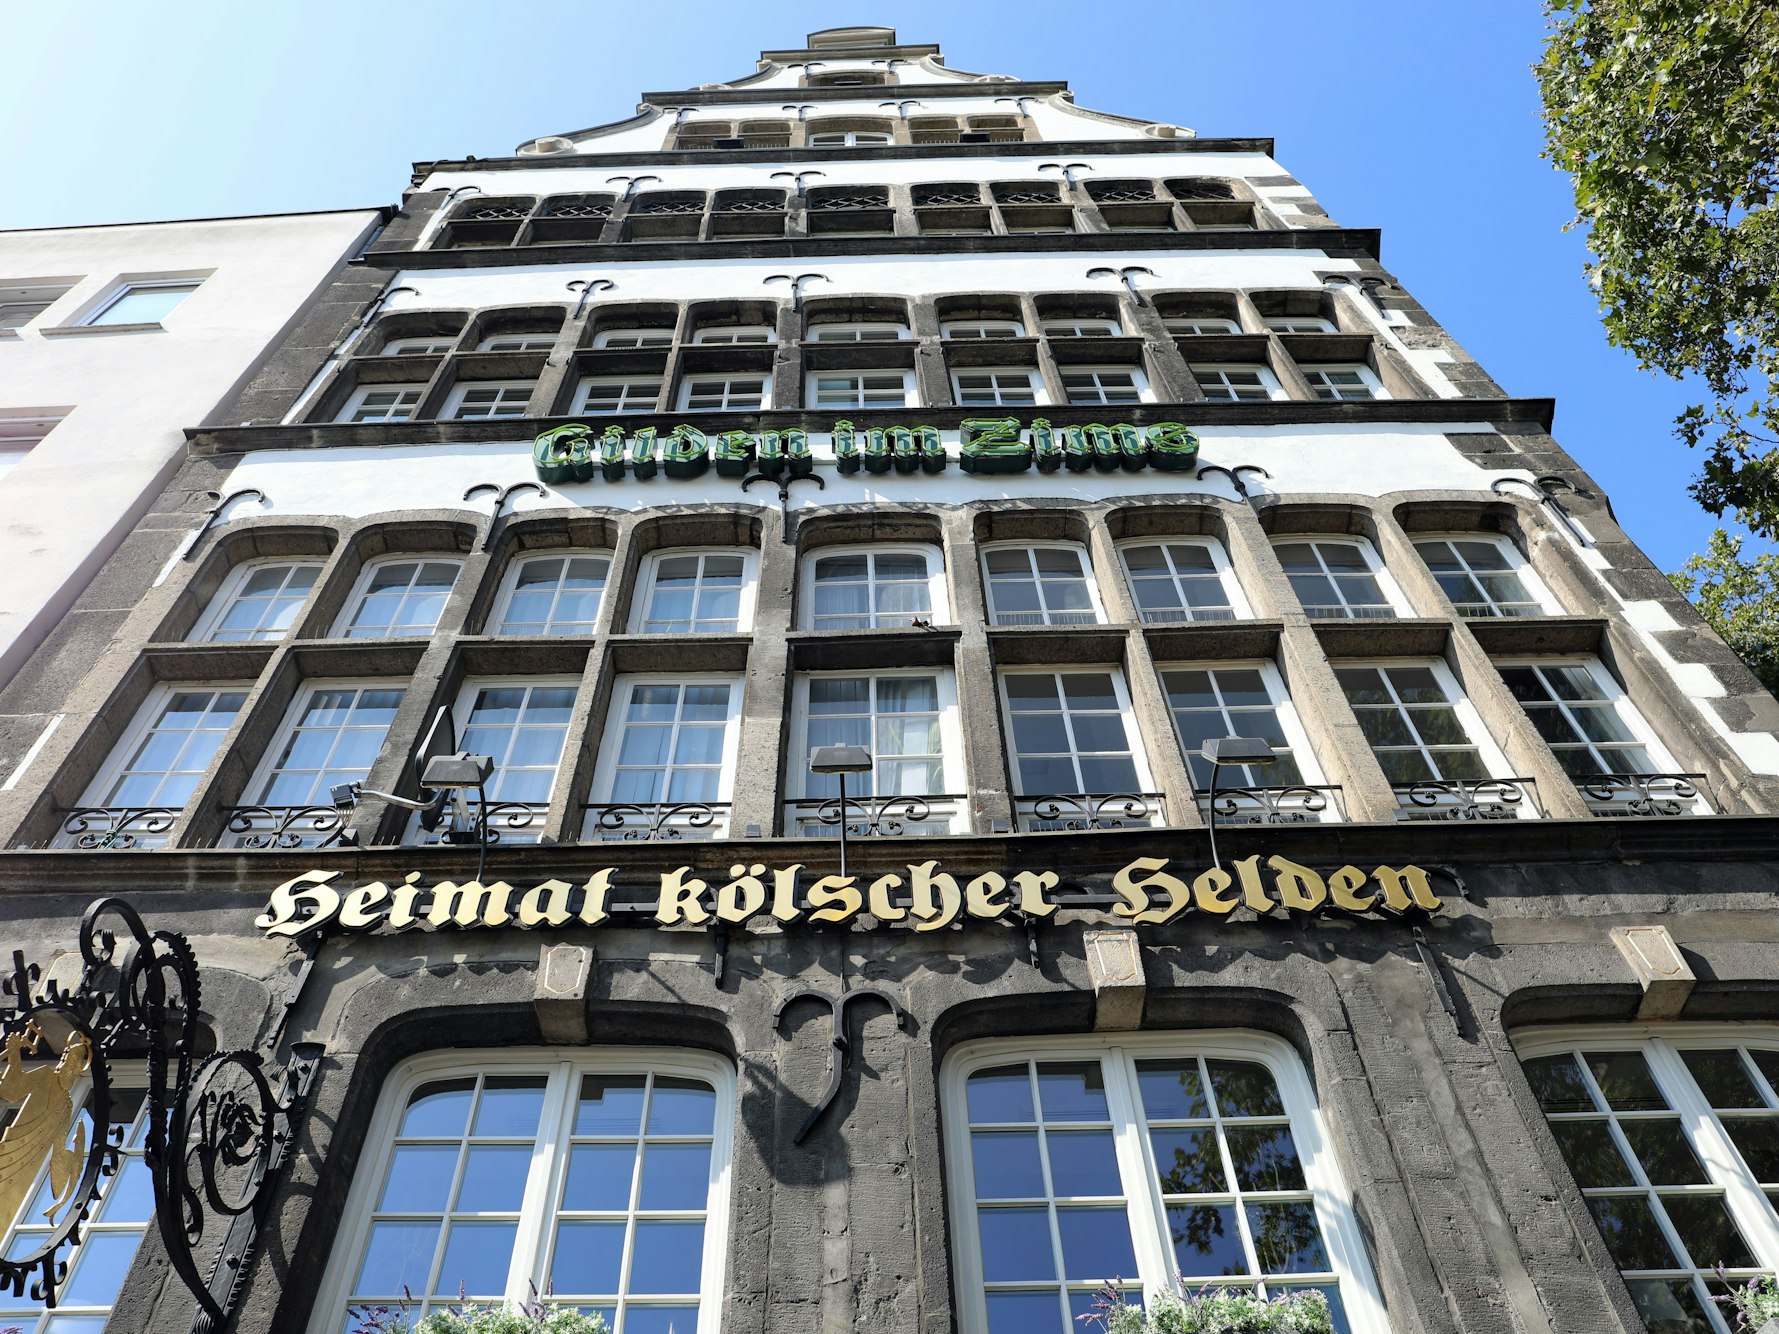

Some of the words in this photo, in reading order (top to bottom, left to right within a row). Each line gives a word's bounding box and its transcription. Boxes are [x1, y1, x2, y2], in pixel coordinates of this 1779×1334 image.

[532, 422, 814, 484] Gilden
[831, 417, 948, 476] im
[958, 416, 1200, 475] Zims
[254, 866, 620, 938] Heimat
[653, 860, 1062, 934] kölscher
[1111, 853, 1444, 926] Helden
